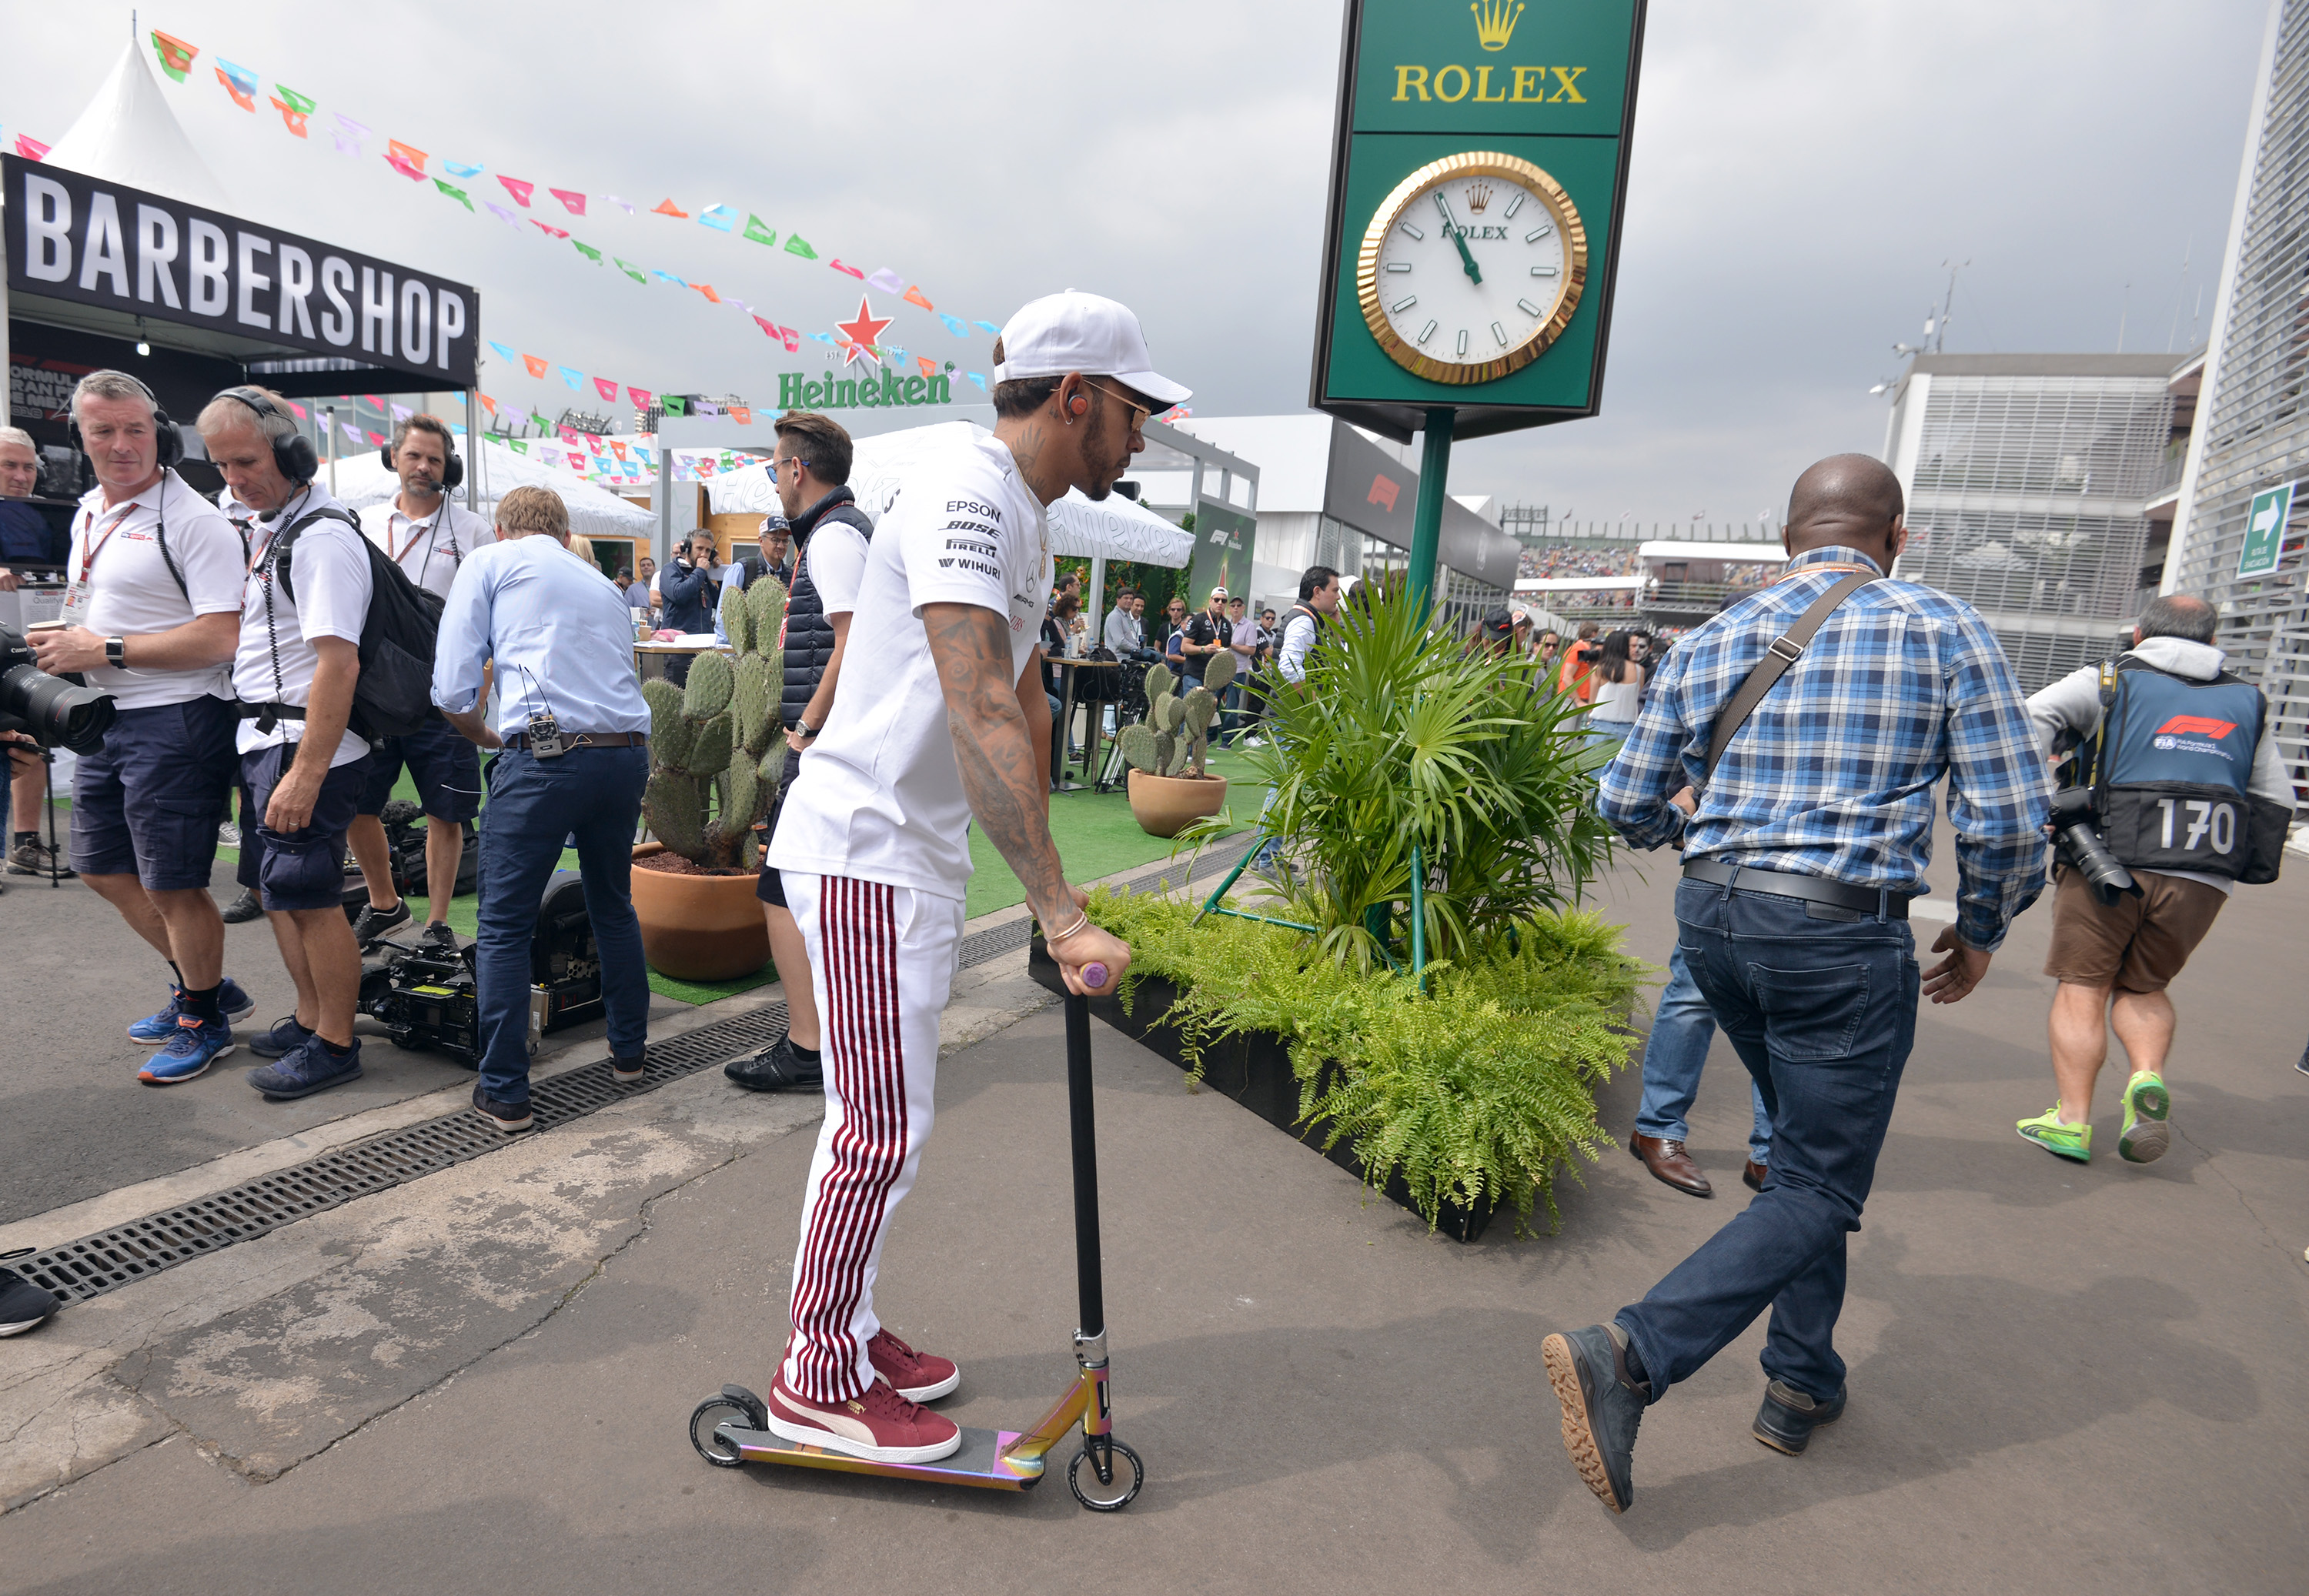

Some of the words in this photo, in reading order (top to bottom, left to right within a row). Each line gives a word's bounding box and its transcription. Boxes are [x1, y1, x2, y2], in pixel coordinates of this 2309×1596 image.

[1392, 65, 1587, 102] ROLEX
[25, 173, 465, 369] BARBERSHOP
[825, 351, 839, 359] EST
[10, 366, 77, 388] ORMUL
[10, 379, 54, 396] RAN
[777, 367, 951, 409] Heineken
[10, 405, 44, 419] 018
[946, 501, 1001, 523] EPSON
[941, 521, 1003, 539] BOSE
[946, 539, 997, 558] PIRELLI
[957, 559, 1001, 580] WIHURI
[2155, 738, 2175, 747] FIA
[2157, 799, 2235, 855] 170
